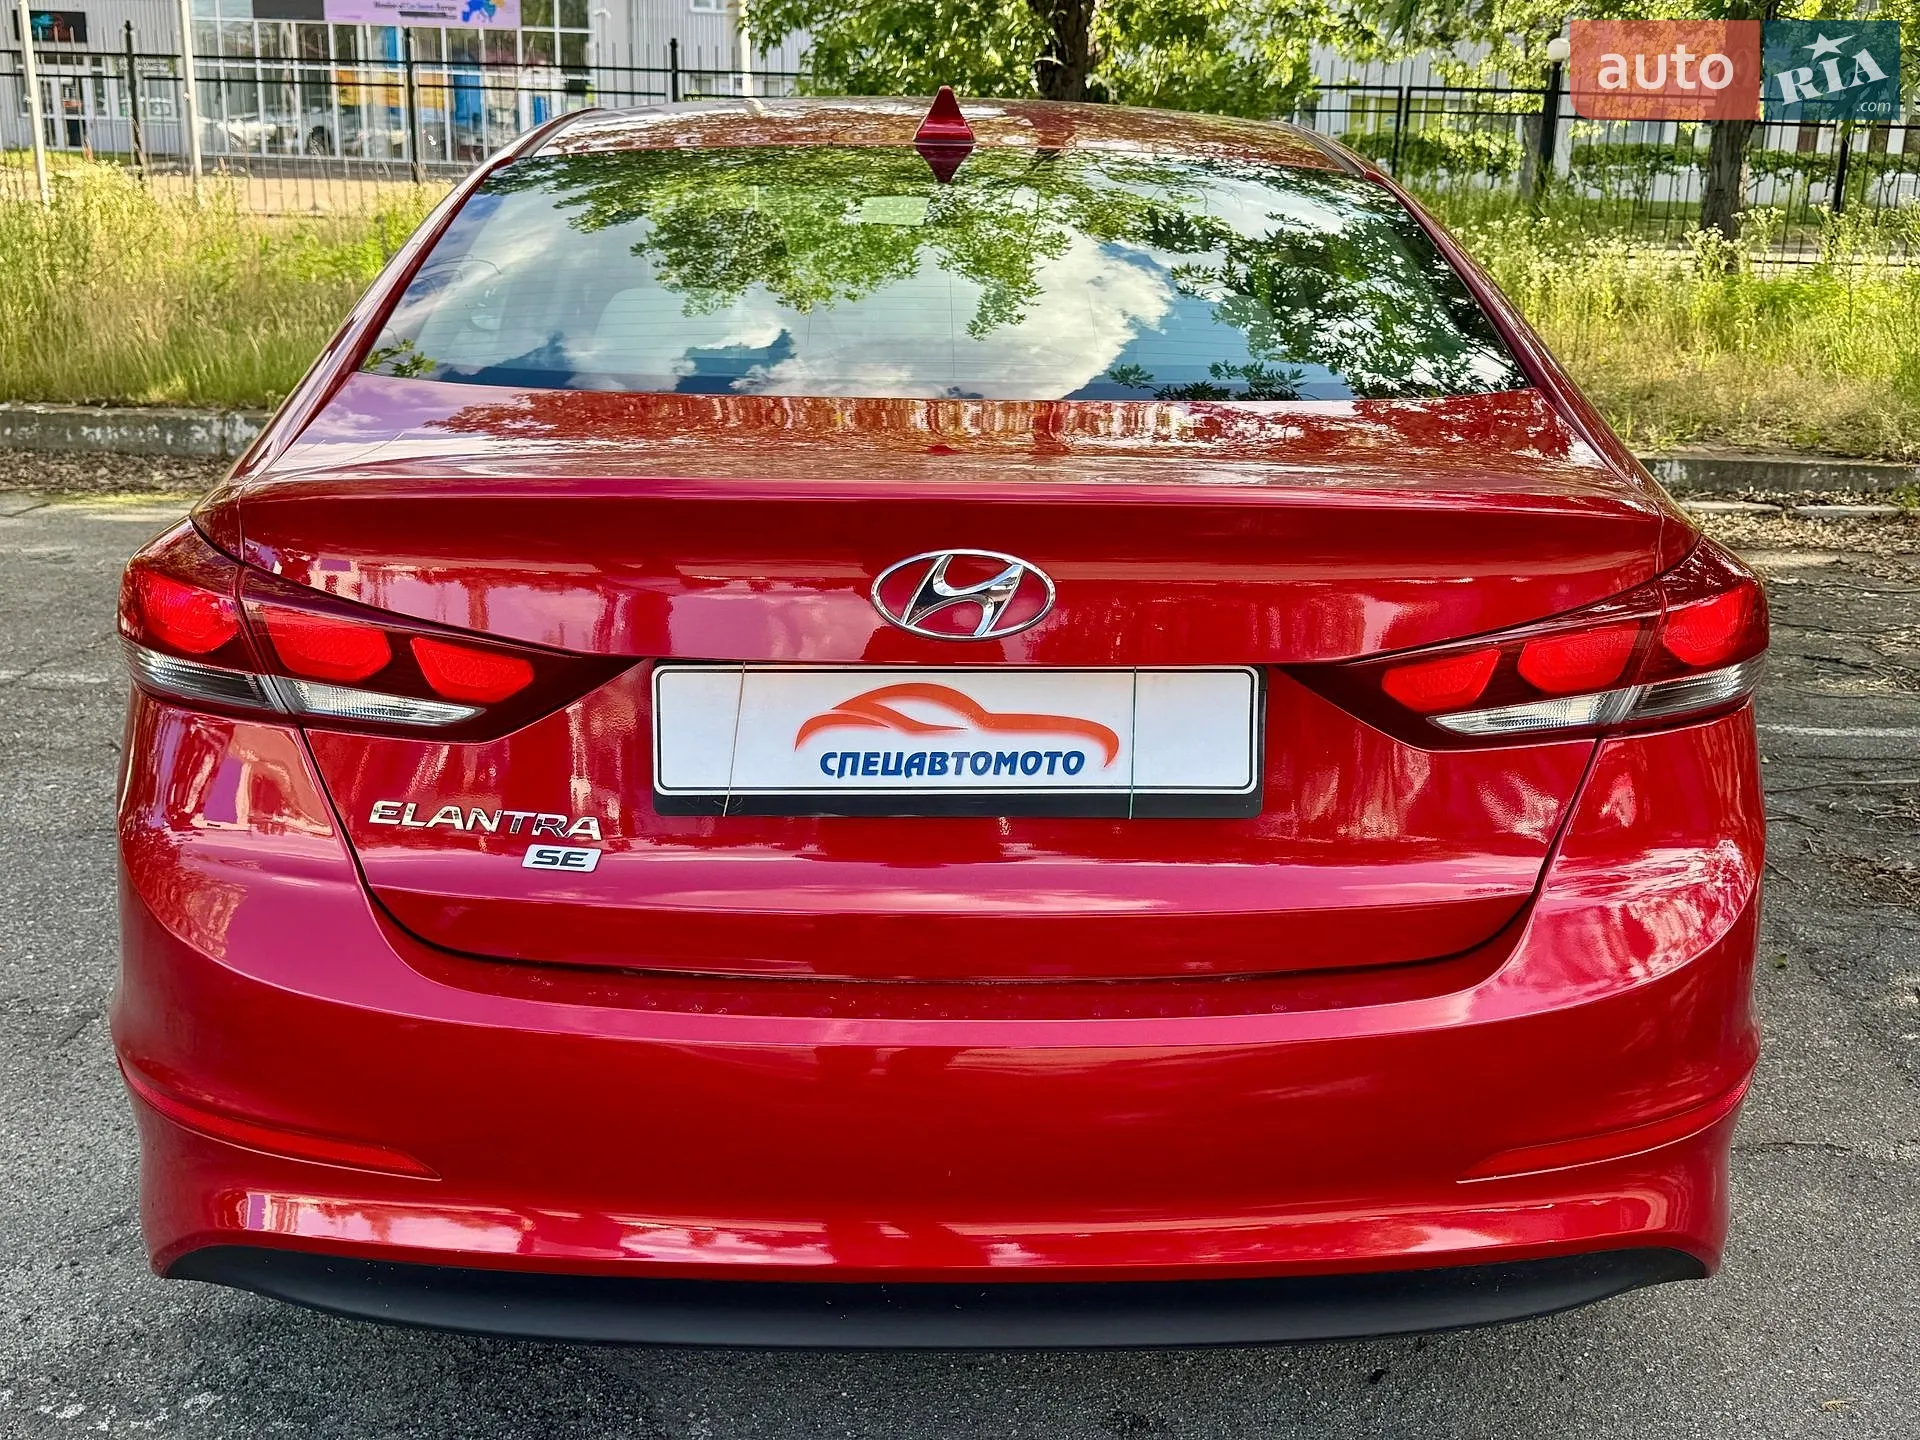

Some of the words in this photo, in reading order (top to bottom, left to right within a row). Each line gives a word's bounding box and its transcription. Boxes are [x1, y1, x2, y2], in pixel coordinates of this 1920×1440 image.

[819, 750, 1085, 779] СПЕЦАВТОМОТО
[368, 799, 603, 841] ELANTRA
[531, 848, 590, 868] SE
